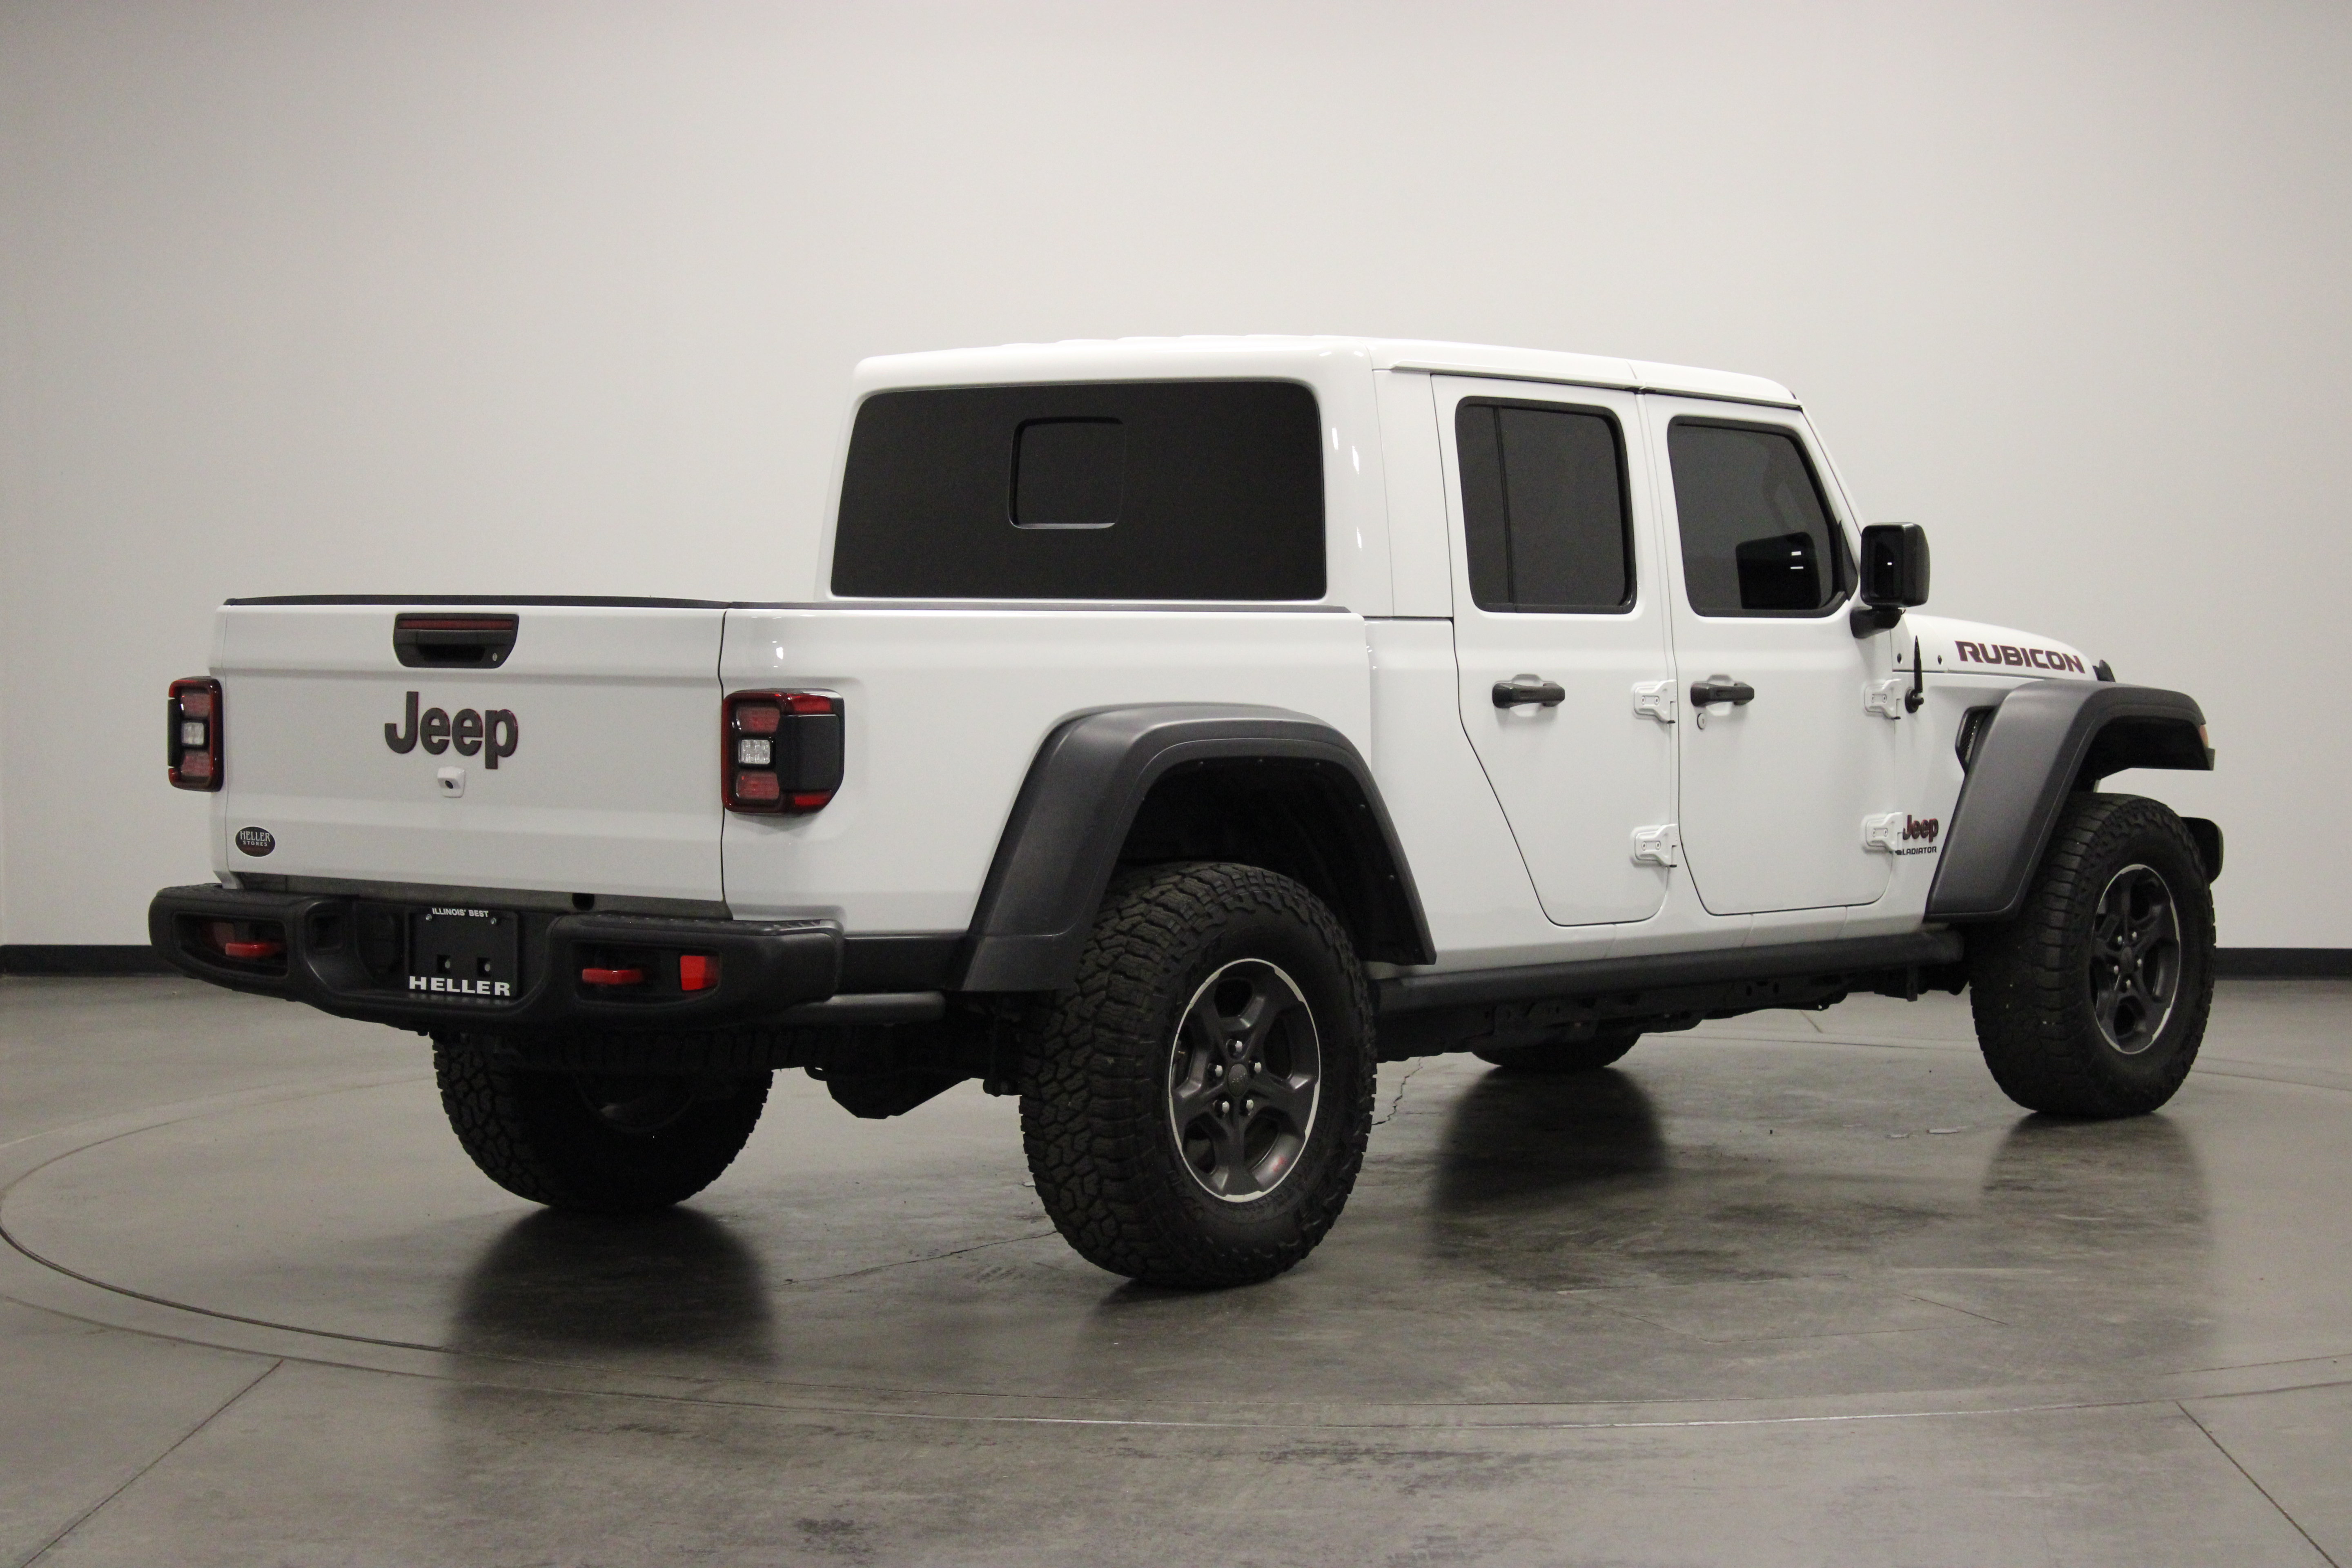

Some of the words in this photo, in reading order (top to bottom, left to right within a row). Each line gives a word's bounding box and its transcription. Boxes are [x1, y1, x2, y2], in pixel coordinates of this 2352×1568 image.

[1955, 641, 2085, 674] RUBICON
[385, 691, 518, 769] Jeep
[240, 831, 270, 842] HELLER
[1902, 815, 1939, 843] Jeep
[432, 908, 466, 916] ILLINOIS'
[468, 909, 489, 918] BEST
[409, 976, 510, 996] HELLER
